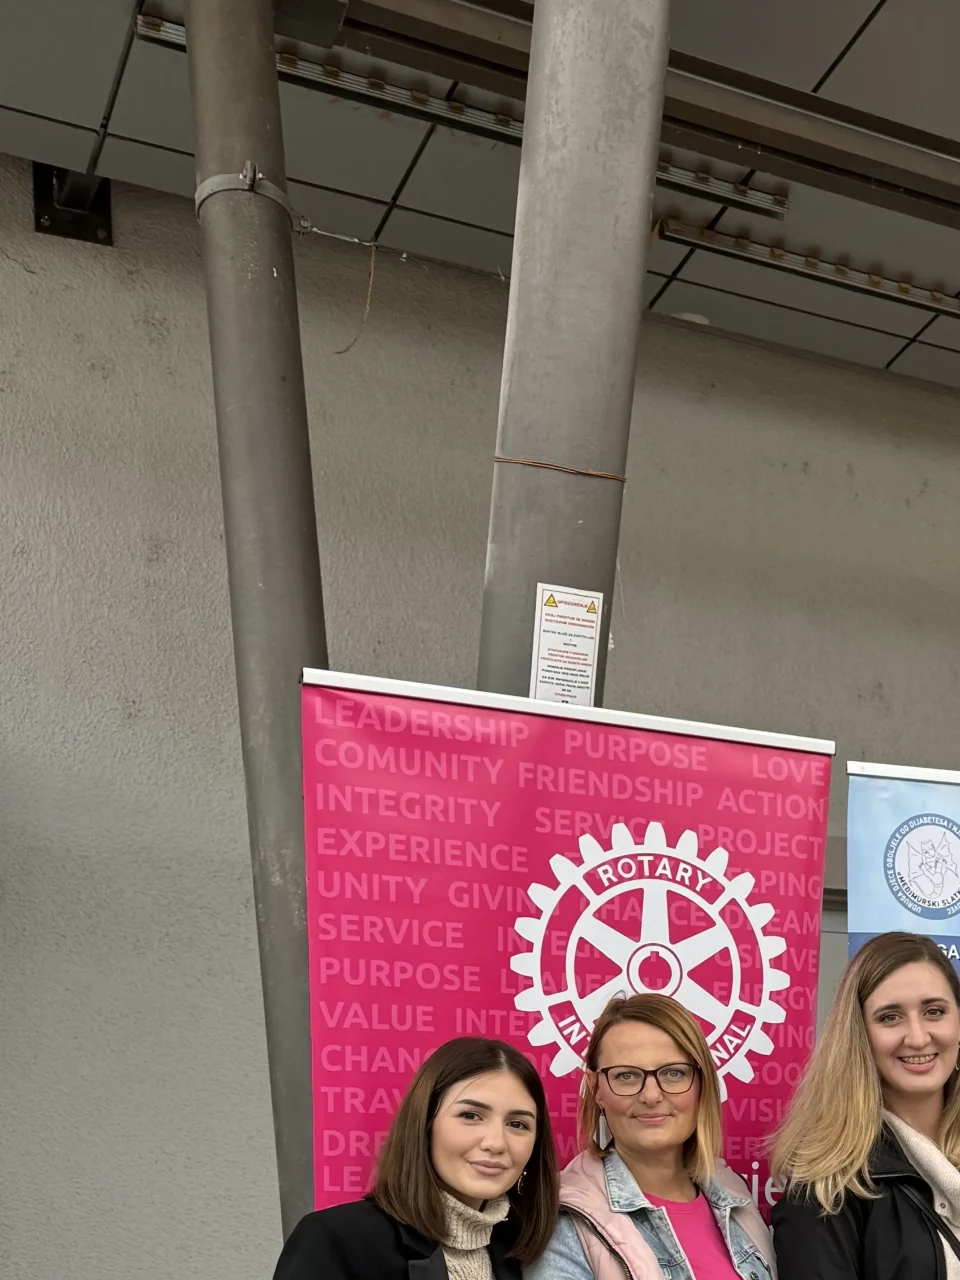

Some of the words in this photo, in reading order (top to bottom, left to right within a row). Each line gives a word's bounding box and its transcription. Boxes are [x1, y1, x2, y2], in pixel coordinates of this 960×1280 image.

[314, 696, 529, 747] LEADERSHIP
[564, 728, 707, 772] PURPOSE
[751, 753, 825, 786] LOVE
[314, 738, 504, 784] COMUNITY
[518, 761, 704, 807] FRIENDSHIP
[717, 787, 825, 823] ACTION
[316, 782, 501, 827] INTEGRITY
[698, 823, 823, 861] PROJECT
[317, 827, 529, 873] EXPERIENCE
[317, 870, 428, 904] UNITY
[597, 855, 713, 892] ROTARY
[317, 912, 464, 949] SERVICE
[319, 957, 481, 992] PURPOSE
[319, 1001, 435, 1032] VALUE
